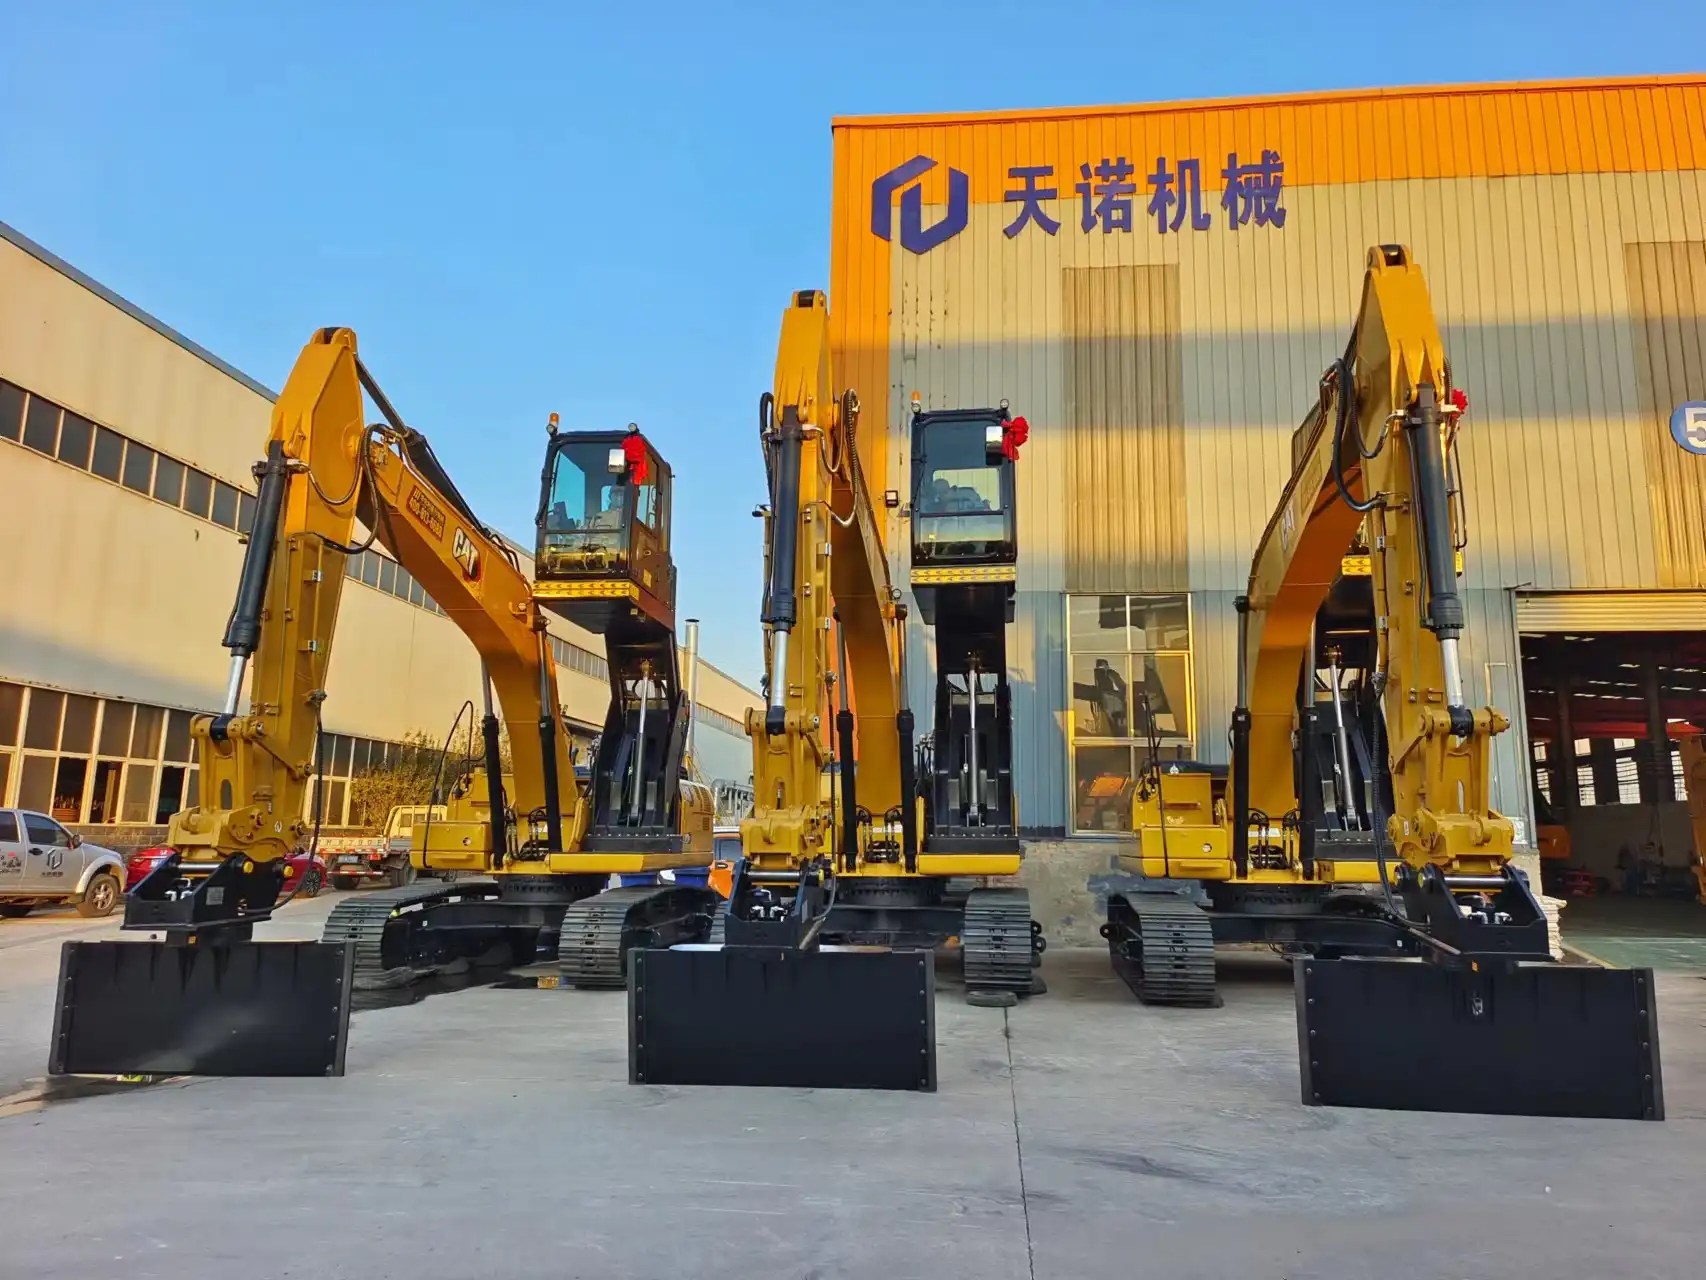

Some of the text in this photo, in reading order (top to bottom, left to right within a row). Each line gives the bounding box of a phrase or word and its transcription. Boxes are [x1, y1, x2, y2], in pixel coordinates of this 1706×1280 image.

[1002, 149, 1287, 240] 天诺机械
[1685, 407, 1706, 449] 5
[453, 527, 479, 576] CAT
